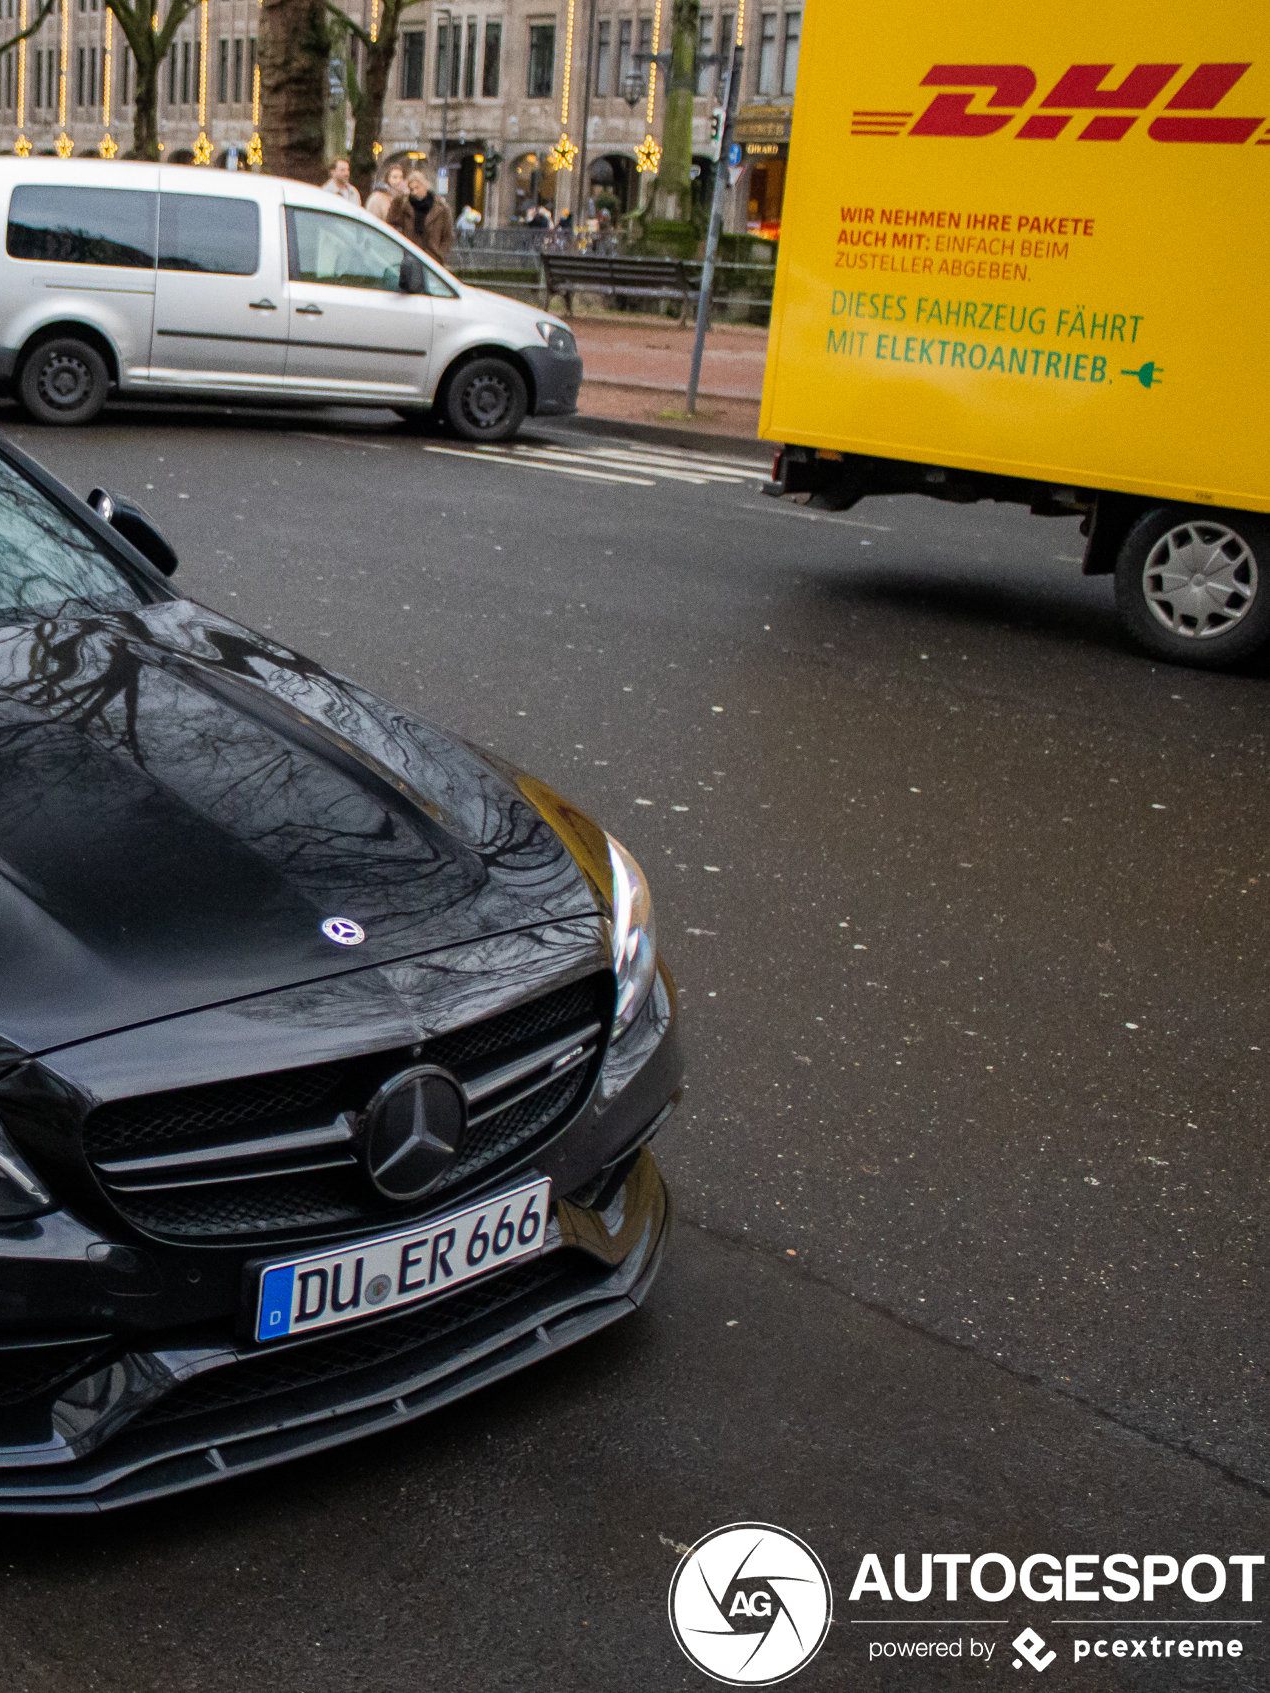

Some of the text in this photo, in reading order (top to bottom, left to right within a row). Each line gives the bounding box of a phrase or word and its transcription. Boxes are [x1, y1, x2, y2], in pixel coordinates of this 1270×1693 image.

[906, 62, 1267, 145] DHL
[840, 207, 1096, 237] WIR NEHMEN IHRE PAKETE
[837, 229, 1070, 260] AUCH MIT: EINFACH BEIM
[834, 251, 1032, 282] ZUSTELLER ABGEBEN.
[831, 290, 1145, 344] DIESES FAHRZEUG FÄHRT
[826, 329, 1113, 385] MIT ELEKTROANTRIEB.
[294, 1193, 541, 1324] DU ER 666
[269, 1310, 281, 1326] D
